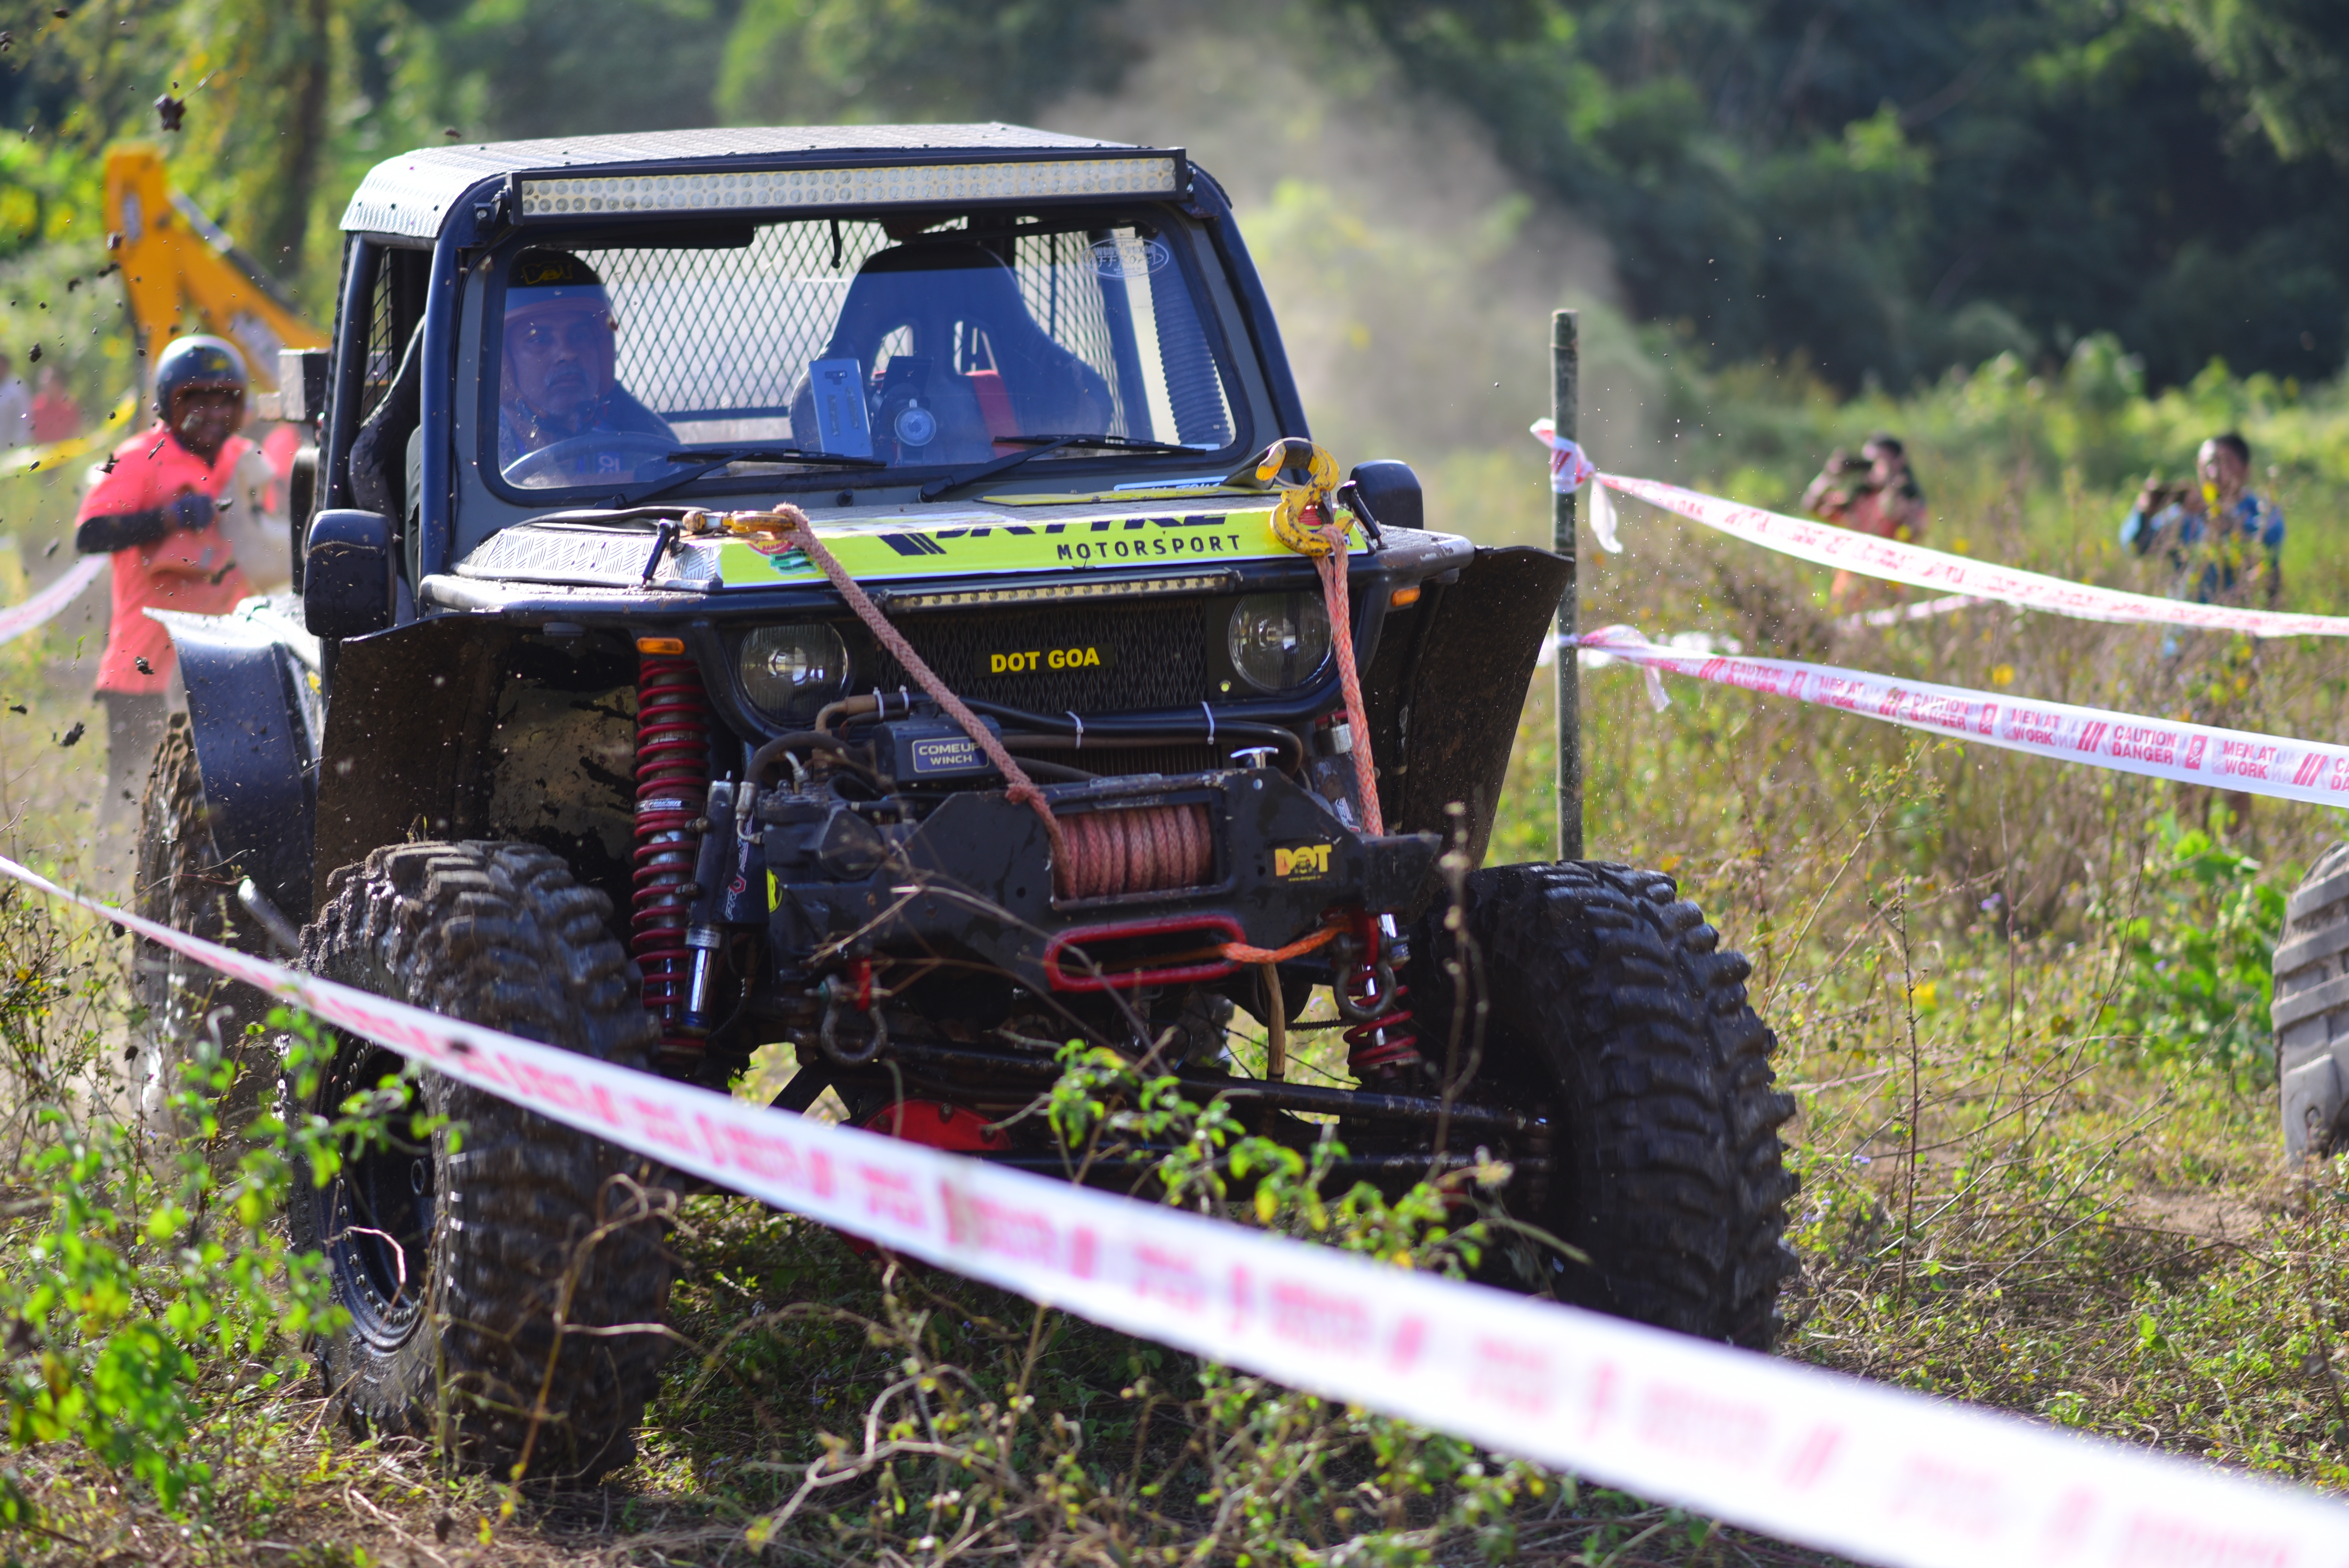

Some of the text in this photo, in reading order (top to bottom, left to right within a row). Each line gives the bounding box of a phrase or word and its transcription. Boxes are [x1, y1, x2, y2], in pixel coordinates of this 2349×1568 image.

[1057, 535, 1240, 560] MOTORSPORT
[991, 647, 1100, 673] DOT GOA
[1731, 661, 1782, 680] CAUTION
[1847, 682, 1864, 695] AT
[1913, 693, 1970, 714] CAUTION
[2012, 708, 2060, 728] MEN AT
[2014, 726, 2054, 745] WORK
[2114, 725, 2177, 748] CAUTION
[919, 742, 980, 756] COMEUP
[2112, 741, 2174, 765] DANGER
[2223, 740, 2277, 761] MEN AT
[930, 754, 973, 766] WINCH
[2226, 759, 2268, 780] WORK
[1275, 844, 1332, 877] DOT
